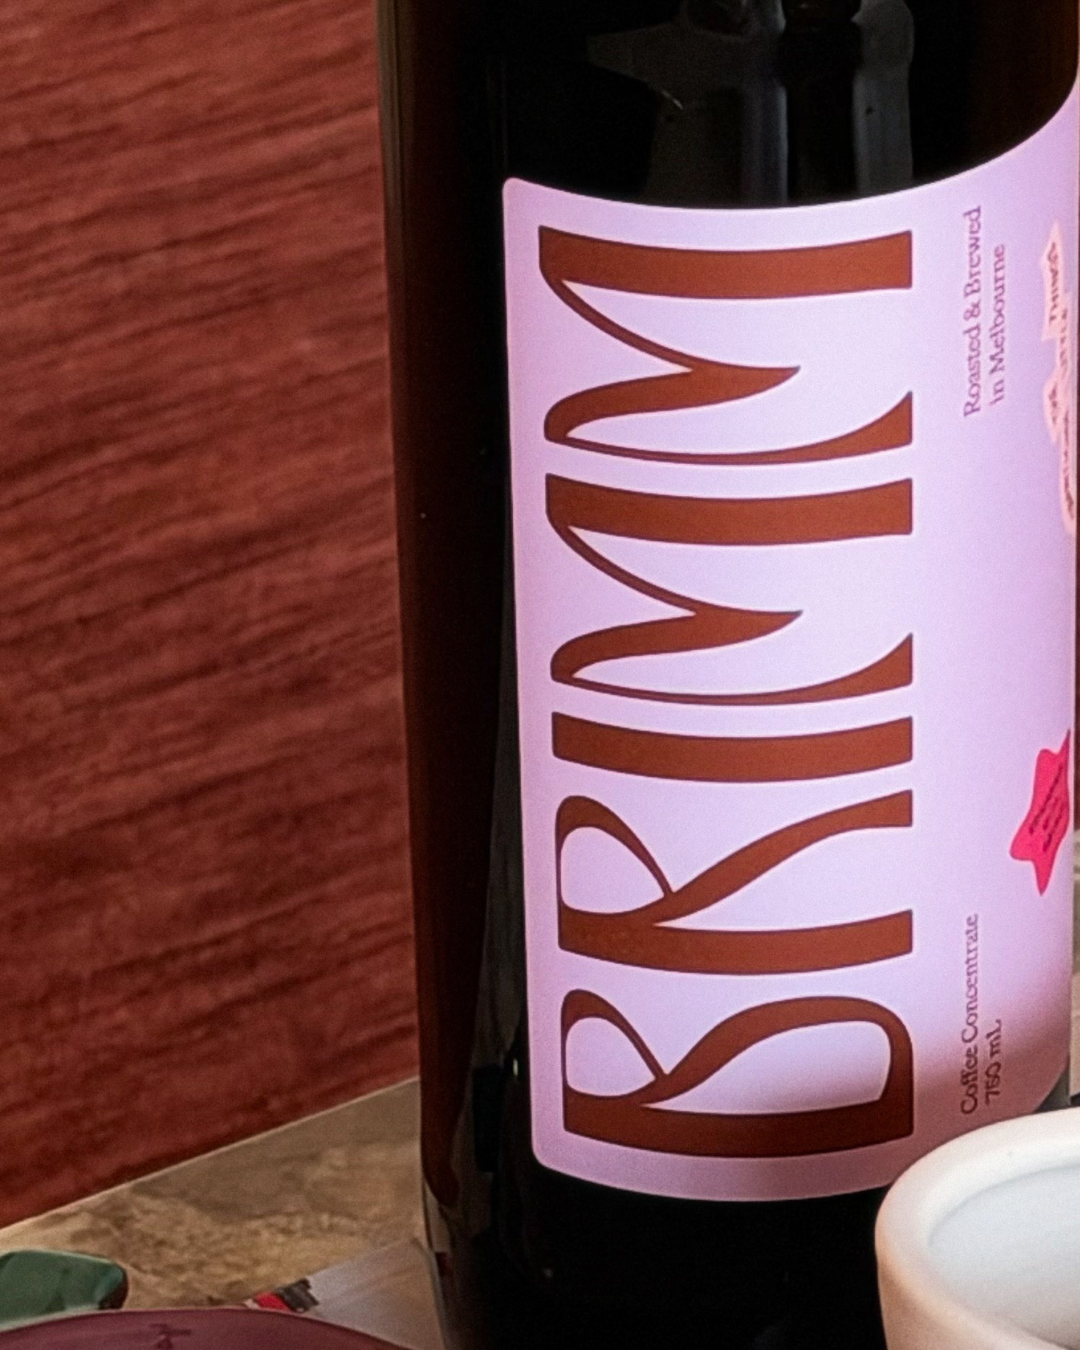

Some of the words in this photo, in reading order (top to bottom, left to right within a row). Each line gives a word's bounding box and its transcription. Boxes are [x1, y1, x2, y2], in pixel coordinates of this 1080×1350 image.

[963, 205, 981, 298] Brewed
[963, 299, 981, 321] &
[989, 244, 1005, 375] Melbourne
[963, 323, 981, 417] Roasted
[990, 379, 1005, 405] in
[539, 224, 914, 1158] BRIMM
[962, 913, 978, 1044] Concentrate
[960, 1044, 978, 1114] Coffee
[986, 1018, 1002, 1060] mL
[985, 1062, 1002, 1105] 750
